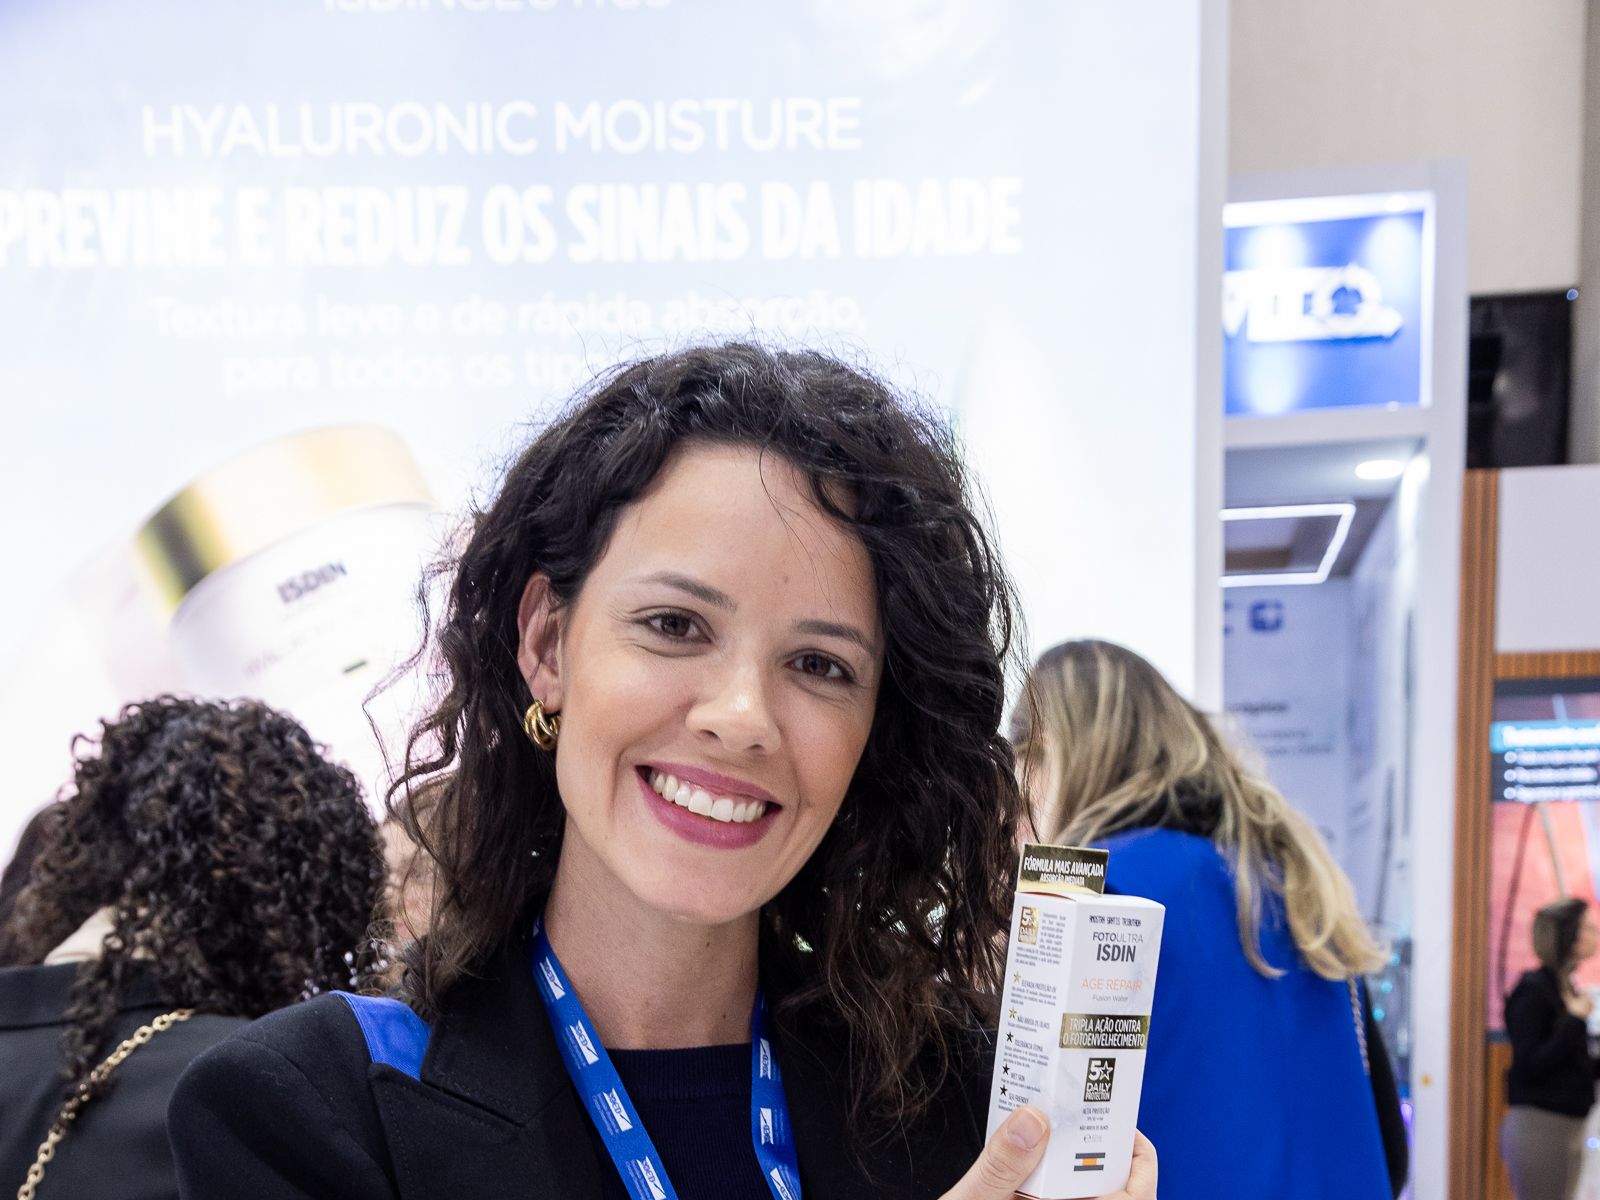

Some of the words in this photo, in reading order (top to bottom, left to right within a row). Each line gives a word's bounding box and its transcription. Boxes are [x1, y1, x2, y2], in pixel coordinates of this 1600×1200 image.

[142, 100, 538, 157] HYALURONIC
[555, 96, 863, 155] MOISTURE
[237, 186, 274, 268] E
[285, 185, 471, 267] REDUZ
[483, 184, 558, 265] OS
[567, 181, 751, 264] SINAIS
[761, 180, 841, 261] DA
[854, 176, 1024, 258] IDADE
[277, 562, 347, 603] ISDIN
[1023, 855, 1053, 873] FÓRMULA
[1054, 860, 1071, 874] MAIS
[1070, 861, 1104, 878] AVANÇADA
[1096, 943, 1136, 962] ISDIN
[1082, 978, 1103, 990] AGE
[1107, 979, 1144, 991] REPAIR
[1069, 1018, 1094, 1032] TRIPLA
[1094, 1017, 1114, 1033] AÇÃO
[1115, 1019, 1141, 1033] CONTRA
[1062, 1033, 1069, 1045] O
[1070, 1033, 1145, 1047] FOTOENVELHECIMENTO
[1088, 1060, 1101, 1081] 5
[1086, 1082, 1111, 1093] DAILY
